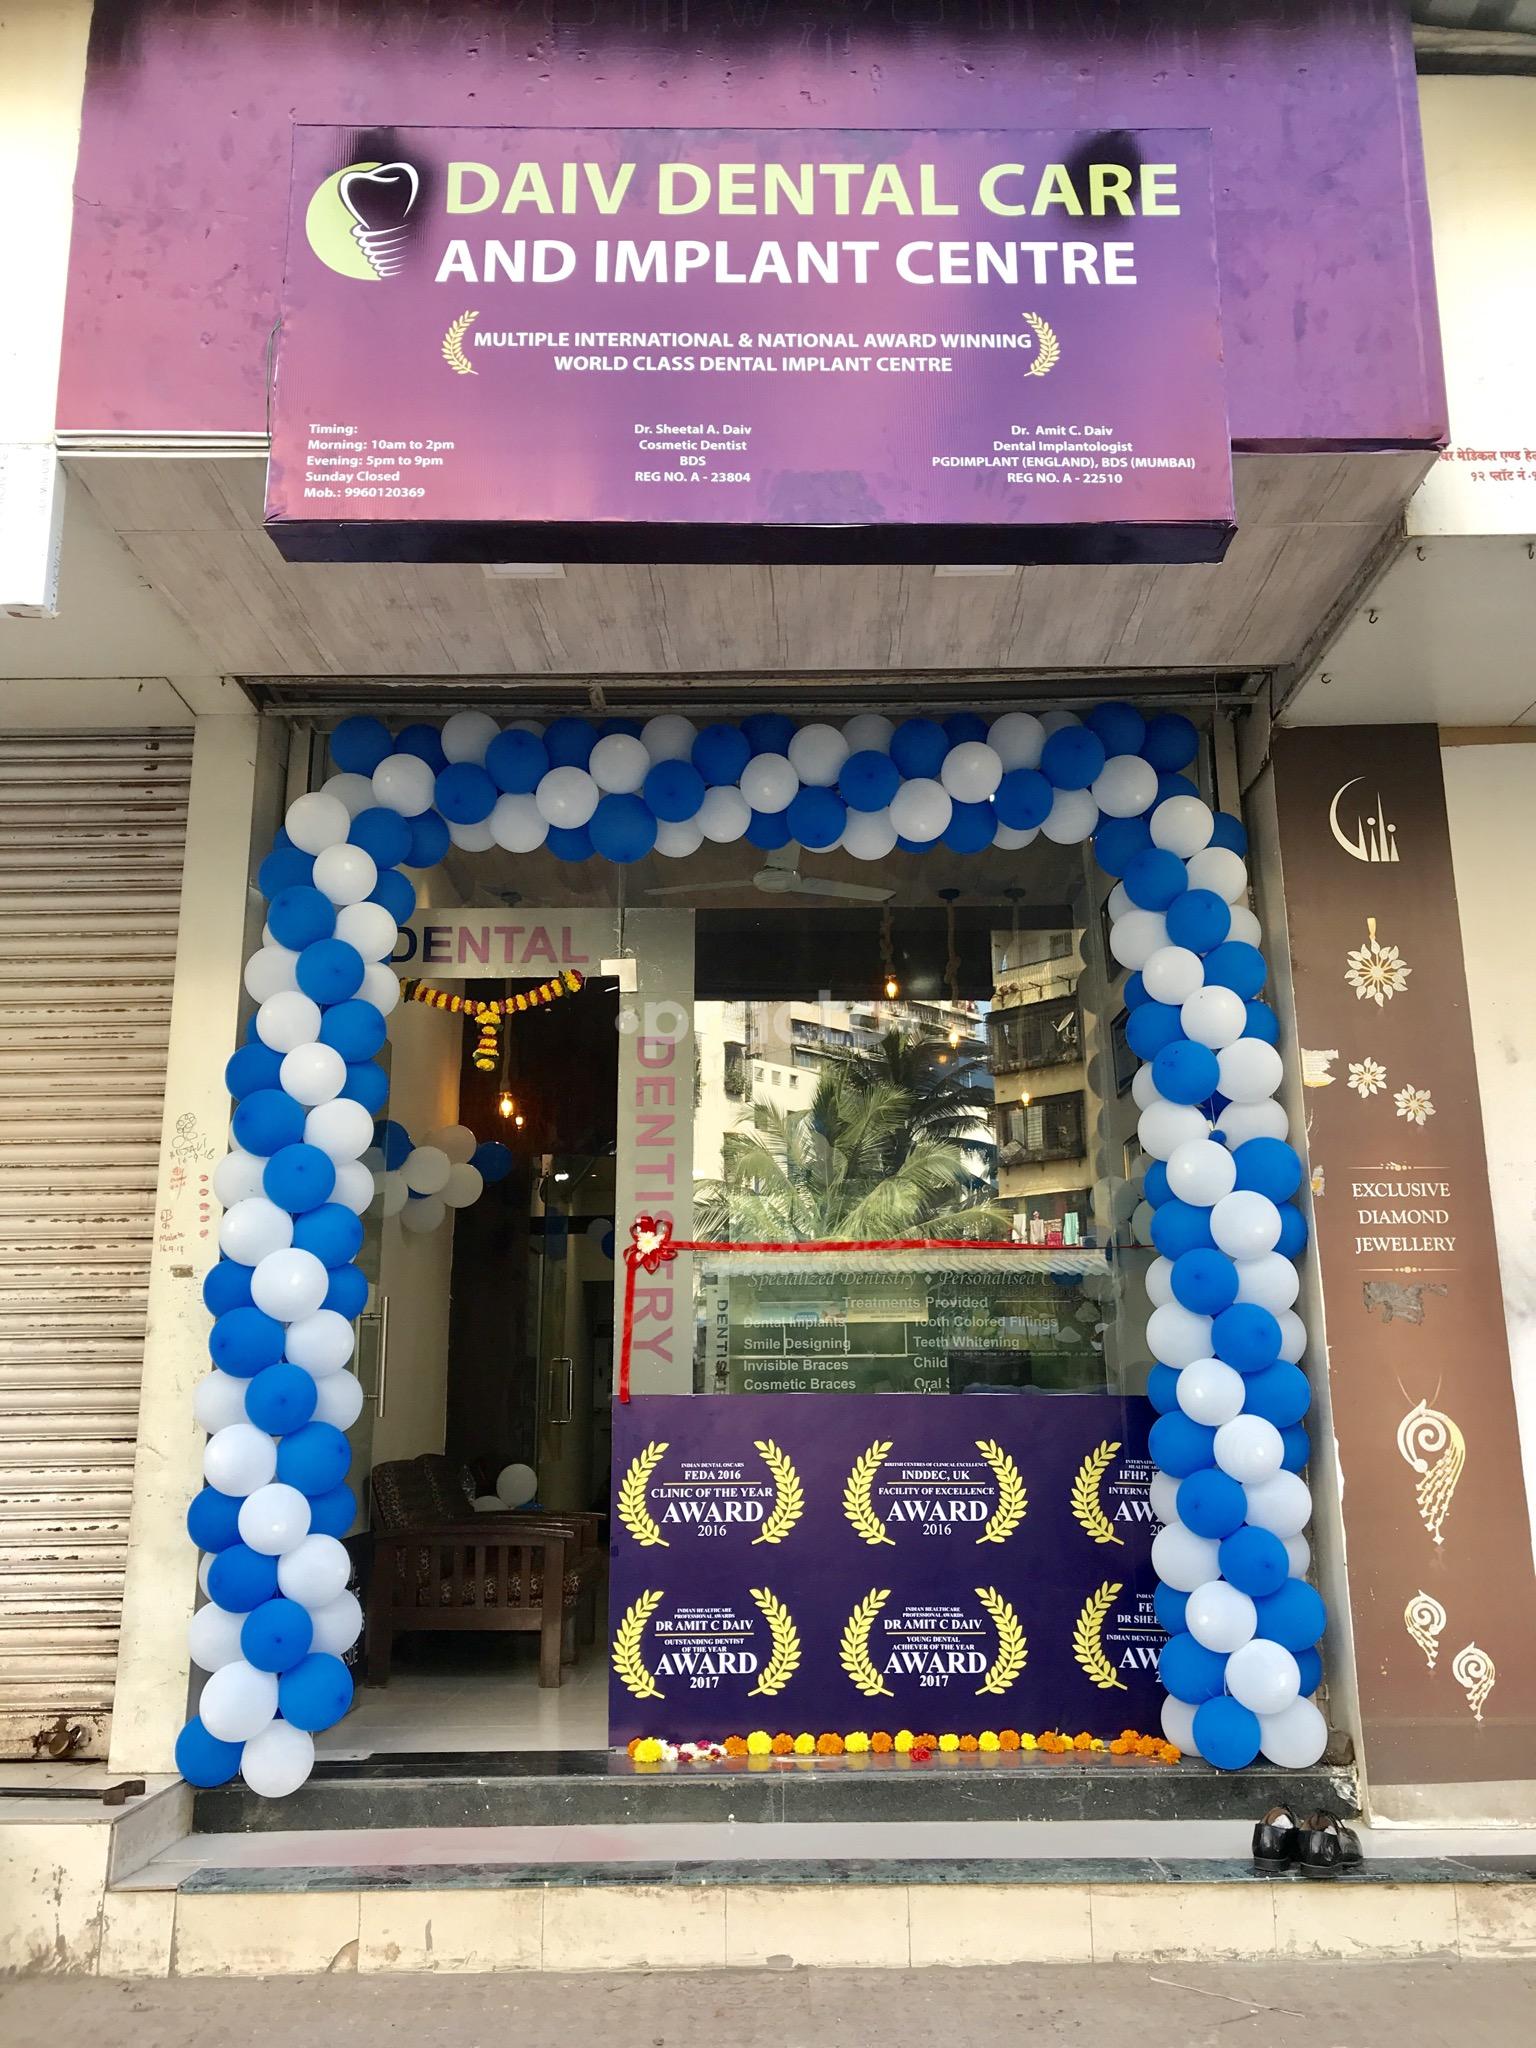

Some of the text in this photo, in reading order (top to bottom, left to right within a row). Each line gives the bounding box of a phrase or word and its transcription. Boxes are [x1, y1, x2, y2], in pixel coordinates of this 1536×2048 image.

[445, 161, 1181, 217] DAIV DENTAL CARE
[434, 239, 1138, 285] AND IMPLANT CENTRE
[474, 332, 1032, 348] MULTIPLE INTERNATIONAL & NATIONAL AWARD WINNING
[553, 355, 953, 372] WORLD CLASS DENTAL IMPLANT CENTRE
[309, 423, 358, 436] Timing:
[634, 423, 752, 435] Dr. Sheetal A. Daiv
[1011, 425, 1113, 436] Dr. Amit C. Daiv
[308, 440, 455, 452] Morning: 10am to 2pm
[639, 439, 748, 451] Cosmetic Dentist
[993, 440, 1133, 454] Dental Implantologist
[306, 455, 444, 468] Evening: 5pm to 9pm
[679, 455, 706, 466] BDS
[931, 456, 1196, 469] PGDIMPLANT (ENGLAND), BDS (MUMBAI)
[305, 471, 400, 484] Sunday Closed
[635, 471, 661, 482] REG
[663, 471, 687, 482] NO.
[690, 471, 700, 482] A
[710, 472, 751, 483] 23804
[1007, 473, 1033, 483] REG
[1036, 473, 1060, 484] NO.
[1062, 473, 1073, 484] A
[1083, 473, 1122, 484] 22510
[303, 487, 425, 498] Mob.: 9960120369
[391, 926, 589, 963] DENTAL
[1351, 1182, 1451, 1199] EXCLUSIVE
[633, 1036, 675, 1363] DENTIRY
[1358, 1208, 1449, 1226] DIAMOND
[1355, 1235, 1457, 1255] JEWELLERY
[840, 1272, 916, 1290] Dentistry
[940, 1271, 1037, 1286] Personalised
[842, 1296, 989, 1309] Treatments Provided
[914, 1316, 1058, 1329] Tooth Colored Fillings
[743, 1338, 851, 1353] Smile Designing
[912, 1336, 1020, 1350] Teeth Whitening
[743, 1359, 849, 1371] Invisible Braces
[913, 1357, 948, 1368] Child
[743, 1378, 857, 1391] Cosmetic Braces
[914, 1377, 945, 1389] Oral
[684, 1470, 741, 1480] FEDA 2016
[902, 1470, 970, 1481] INDDEC, UK
[1119, 1470, 1149, 1481] IFHP,
[651, 1487, 773, 1498] CLINIC OF THE YEAR
[878, 1487, 995, 1495] FACILITY OF EXCELLENCE
[661, 1501, 764, 1523] AWARD
[886, 1500, 988, 1522] AWARD
[697, 1525, 727, 1537] 2016
[922, 1524, 952, 1535] 2016
[884, 1619, 982, 1629] DR AMIT C DAIV
[1117, 1614, 1132, 1623] DR
[655, 1620, 754, 1631] DR AMIT C DAIV
[654, 1652, 758, 1675] AWARD
[883, 1651, 987, 1674] AWARD
[690, 1676, 719, 1689] 2017
[920, 1675, 949, 1687] 2017
